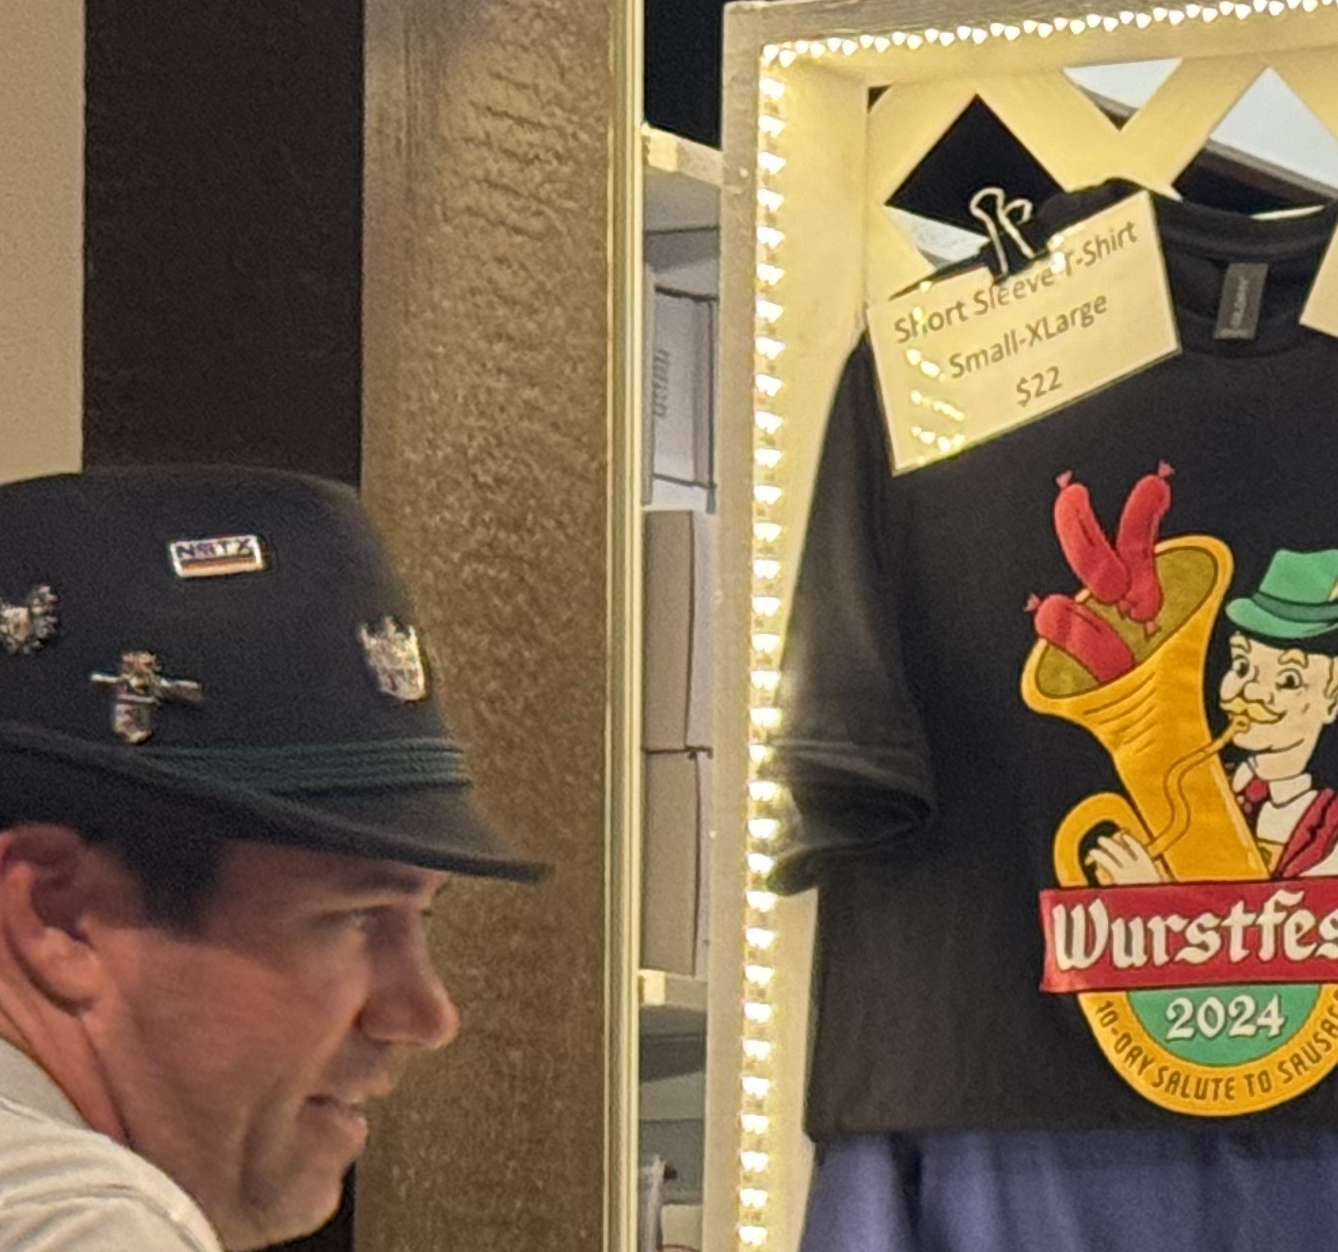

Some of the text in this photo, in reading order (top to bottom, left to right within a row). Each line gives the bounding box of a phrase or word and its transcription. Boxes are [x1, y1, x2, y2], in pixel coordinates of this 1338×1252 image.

[894, 300, 968, 344] Short
[973, 270, 1054, 316] Sleeve
[948, 295, 1108, 379] Small-XLarge
[1016, 366, 1062, 408] $22
[1095, 999, 1153, 1076] 10-DAY
[1152, 1065, 1235, 1101] SALUTE
[1244, 1072, 1273, 1094] TO
[1166, 993, 1284, 1041] 2024
